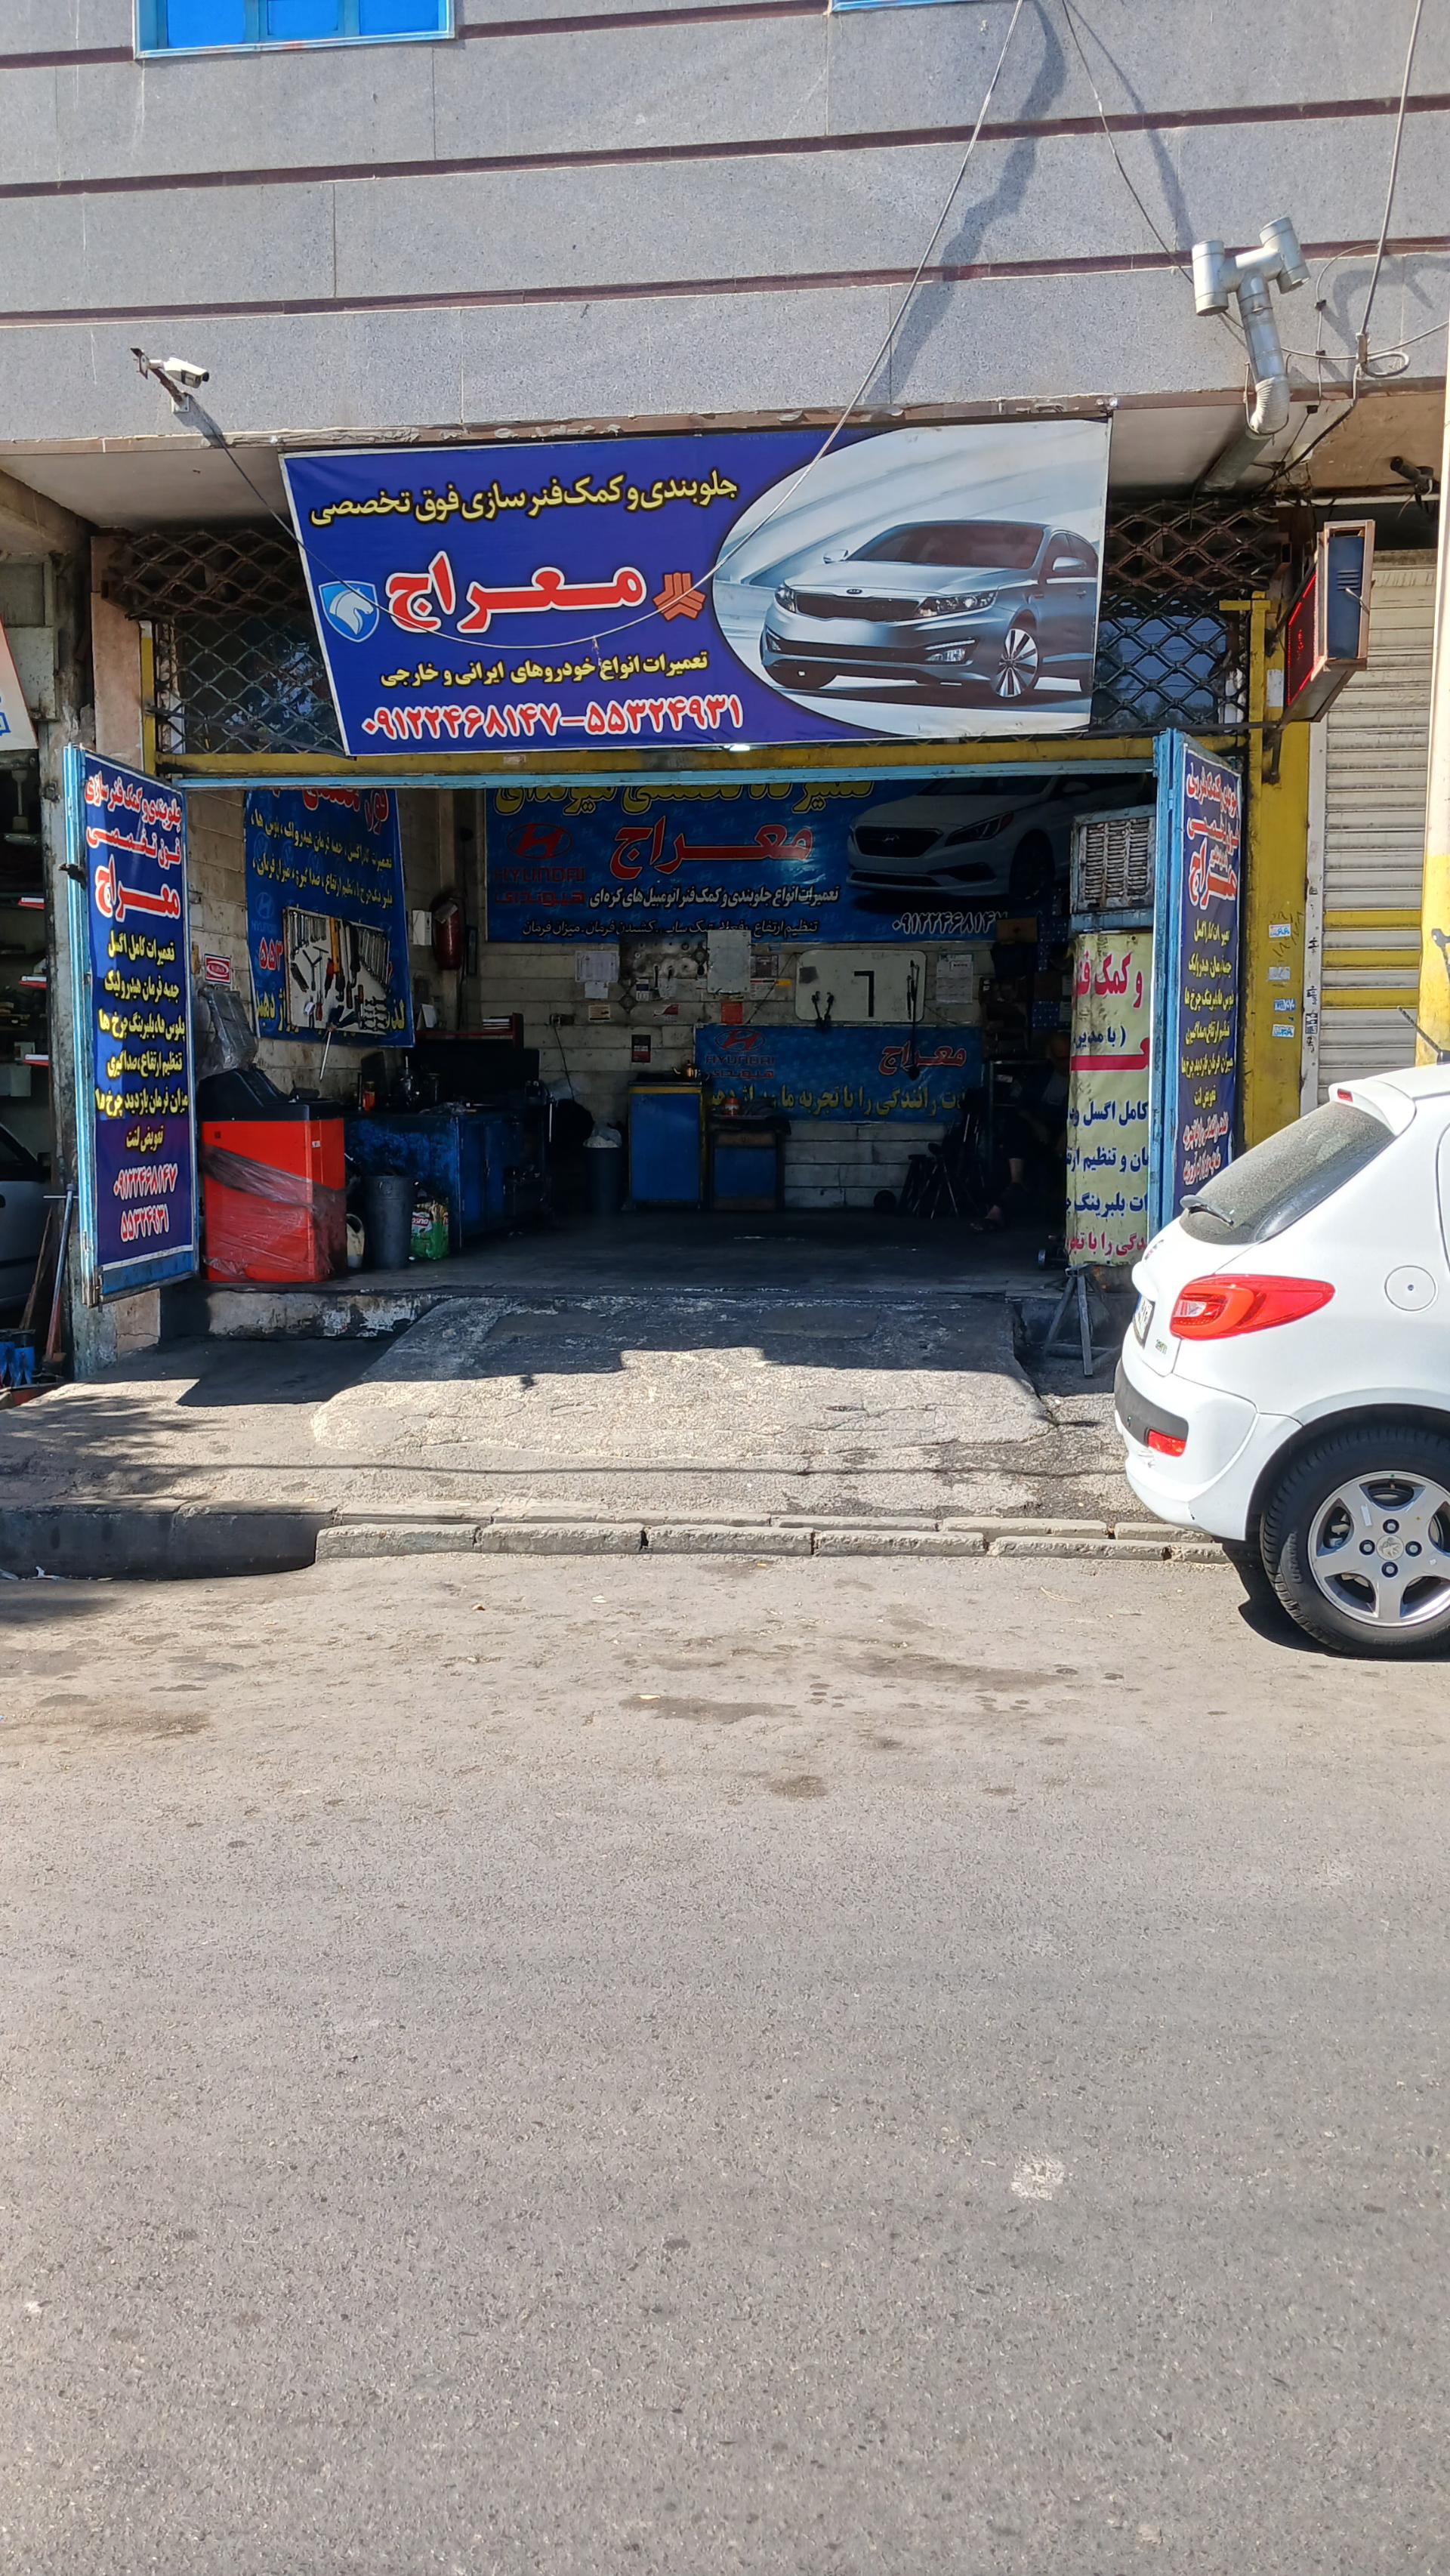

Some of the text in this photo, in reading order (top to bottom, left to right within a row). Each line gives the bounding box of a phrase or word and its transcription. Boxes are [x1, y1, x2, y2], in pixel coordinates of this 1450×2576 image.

[415, 483, 460, 522] فوق
[461, 482, 526, 520] سازی
[626, 487, 640, 511] و
[642, 470, 738, 509] جلوبندی
[310, 491, 411, 526] تخصصی
[385, 551, 646, 634] معراج
[381, 651, 708, 687] تعمیرات انواع خودروهای ایرانی و خارجی
[86, 826, 158, 859] تخصصی
[610, 816, 813, 880] معراج
[495, 866, 586, 883] HYUNDAI
[95, 854, 181, 923] معراج
[643, 887, 680, 908] اتومبیل
[720, 890, 727, 908] و
[727, 886, 772, 907] جلوبندی
[772, 885, 799, 906] انواع
[799, 885, 840, 906] تعمیرات
[522, 920, 552, 936] فرمان
[552, 920, 580, 936] میزان
[754, 920, 784, 938] ارتفاع
[784, 919, 819, 938] تنظیم
[146, 938, 176, 966] تعمیرات
[142, 975, 163, 1003] فرمان
[98, 1008, 111, 1031] ها
[111, 1010, 128, 1039] چرخ
[162, 1050, 183, 1077] تنظیم
[878, 1040, 967, 1075] معراج
[105, 1090, 123, 1117] چرخ
[125, 1087, 149, 1115] بازدید
[149, 1086, 168, 1114] فرمان
[169, 1087, 189, 1114] میزان
[1083, 1100, 1116, 1127] اگسل
[125, 1125, 164, 1152] تعویض لنت
[1083, 1146, 1117, 1172] تنظیم
[1074, 1192, 1125, 1218] بلبرینگ
[1088, 1231, 1100, 1254] با
[1100, 1231, 1112, 1256] را
